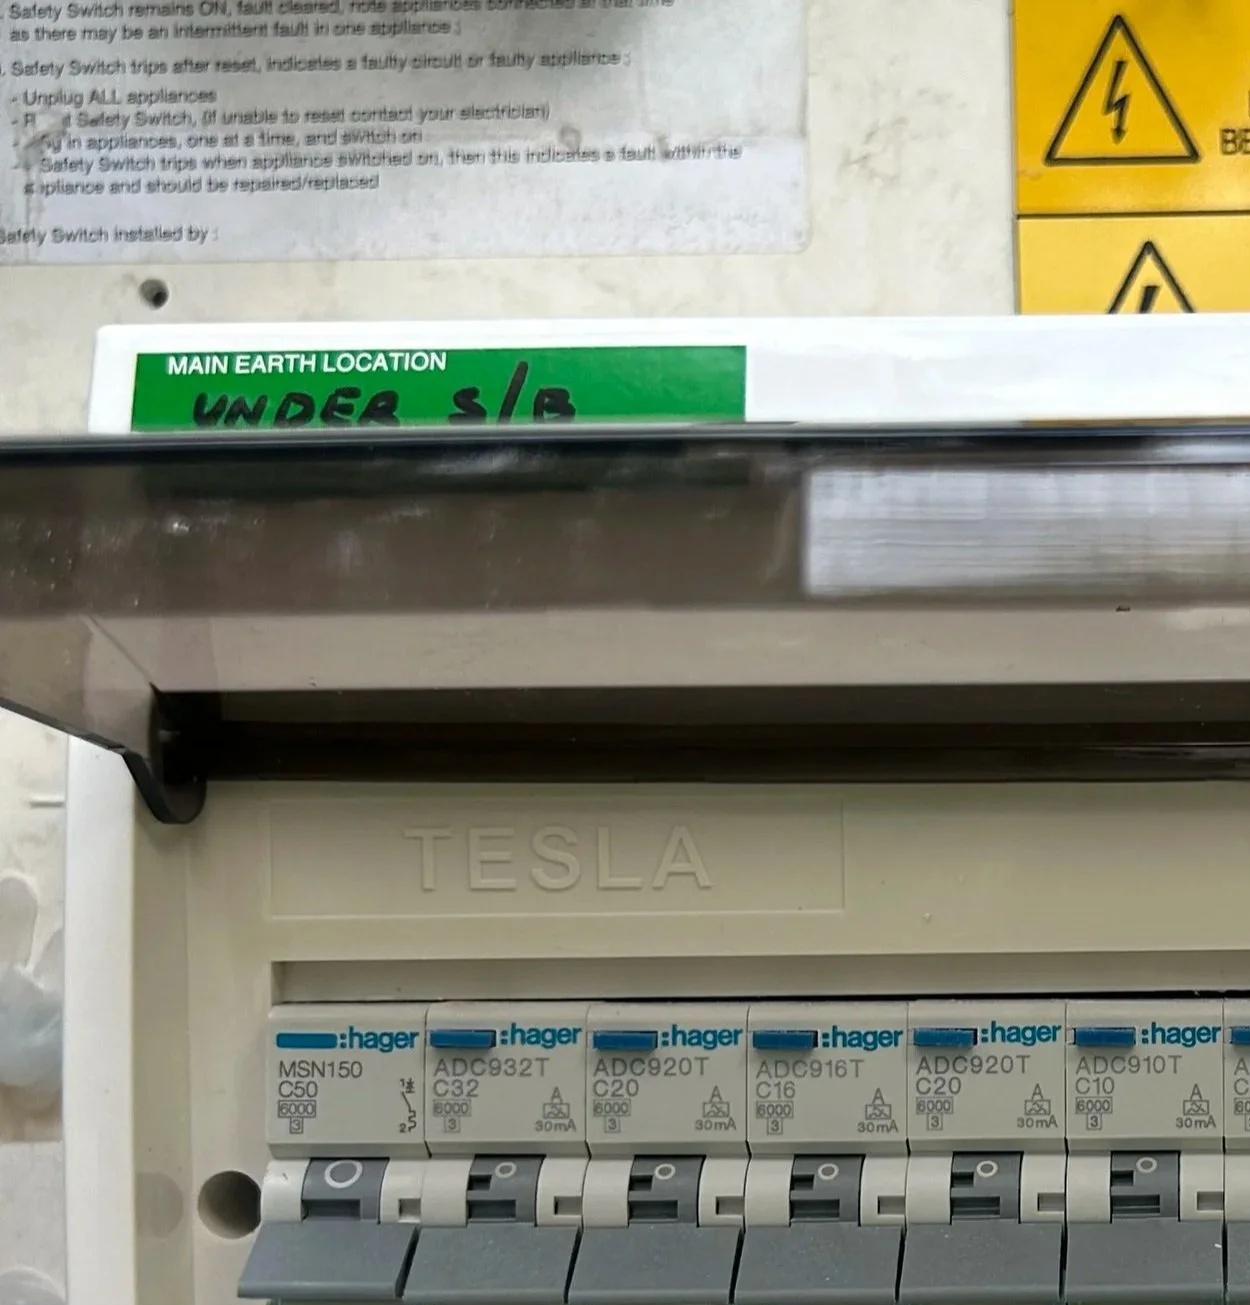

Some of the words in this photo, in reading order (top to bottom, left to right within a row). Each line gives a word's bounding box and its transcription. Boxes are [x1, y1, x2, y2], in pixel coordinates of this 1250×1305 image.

[9, 3, 62, 22] Safety
[66, 2, 123, 19] Switch
[128, 1, 194, 17] remains
[10, 28, 29, 42] as
[34, 25, 76, 41] there
[82, 26, 118, 44] may
[122, 24, 143, 40] be
[148, 25, 168, 39] an
[12, 60, 64, 80] Safety
[69, 58, 126, 77] Switch
[131, 58, 167, 76] trips
[172, 57, 209, 75] after
[23, 88, 83, 108] Unplug
[88, 89, 121, 106] ALL
[76, 111, 130, 131] Safety
[186, 134, 219, 149] one
[41, 156, 94, 176] Safety
[99, 155, 156, 173] Switch
[160, 155, 197, 172] trips
[109, 178, 141, 194] and
[145, 177, 202, 194] should
[206, 177, 228, 193] be
[52, 226, 109, 243] Switch
[114, 225, 184, 243] installed
[187, 226, 209, 246] by
[167, 354, 231, 376] MAIN
[234, 352, 316, 374] EARTH
[322, 351, 447, 373] LOCATION
[192, 385, 402, 431] UNDER
[404, 825, 712, 891] TESLA
[279, 1061, 363, 1078] MSN150
[434, 1057, 550, 1077] ADC932T
[593, 1057, 710, 1077] ADC920T
[756, 1059, 865, 1079] ADC916T
[916, 1055, 1031, 1074] ADC920T
[1076, 1055, 1182, 1074] ADC910T
[278, 1080, 318, 1098] C50
[433, 1080, 479, 1098] C32
[593, 1080, 639, 1098] C20
[756, 1081, 796, 1099] C16
[916, 1077, 962, 1095] C20
[1075, 1077, 1115, 1095] C10
[280, 1102, 315, 1115] 6000
[434, 1103, 468, 1115] 6000
[594, 1103, 628, 1115] 6000
[757, 1104, 792, 1116] 6000
[917, 1100, 951, 1112] 6000
[1077, 1100, 1110, 1112] 6000
[535, 1120, 576, 1132] 30mA
[695, 1119, 737, 1131] 30mA
[857, 1121, 898, 1134] 30mA
[1017, 1117, 1058, 1129] 30mA
[1176, 1117, 1216, 1129] 30mA
